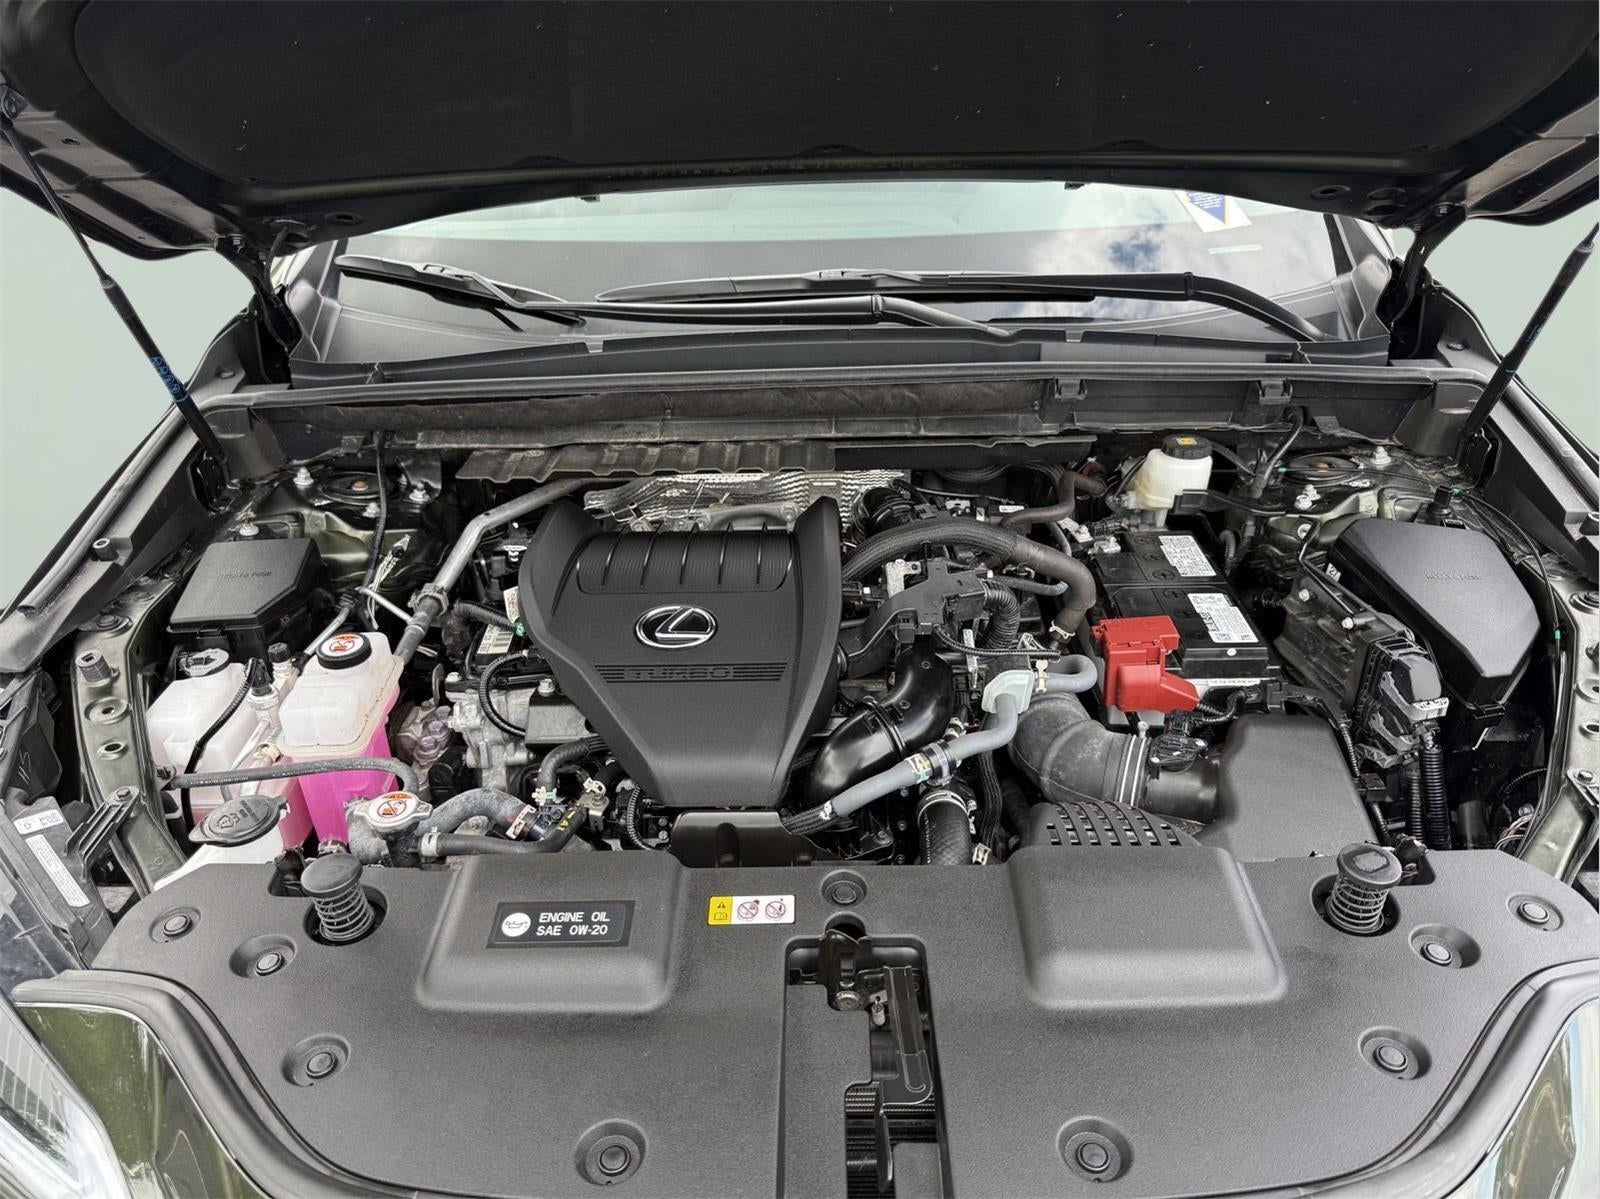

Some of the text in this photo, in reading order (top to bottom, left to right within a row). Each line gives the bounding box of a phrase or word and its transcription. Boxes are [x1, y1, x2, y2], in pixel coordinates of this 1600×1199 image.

[628, 667, 731, 680] TURBO
[539, 911, 611, 923] ENGINE OIL
[536, 924, 608, 936] SAE 0W-20
